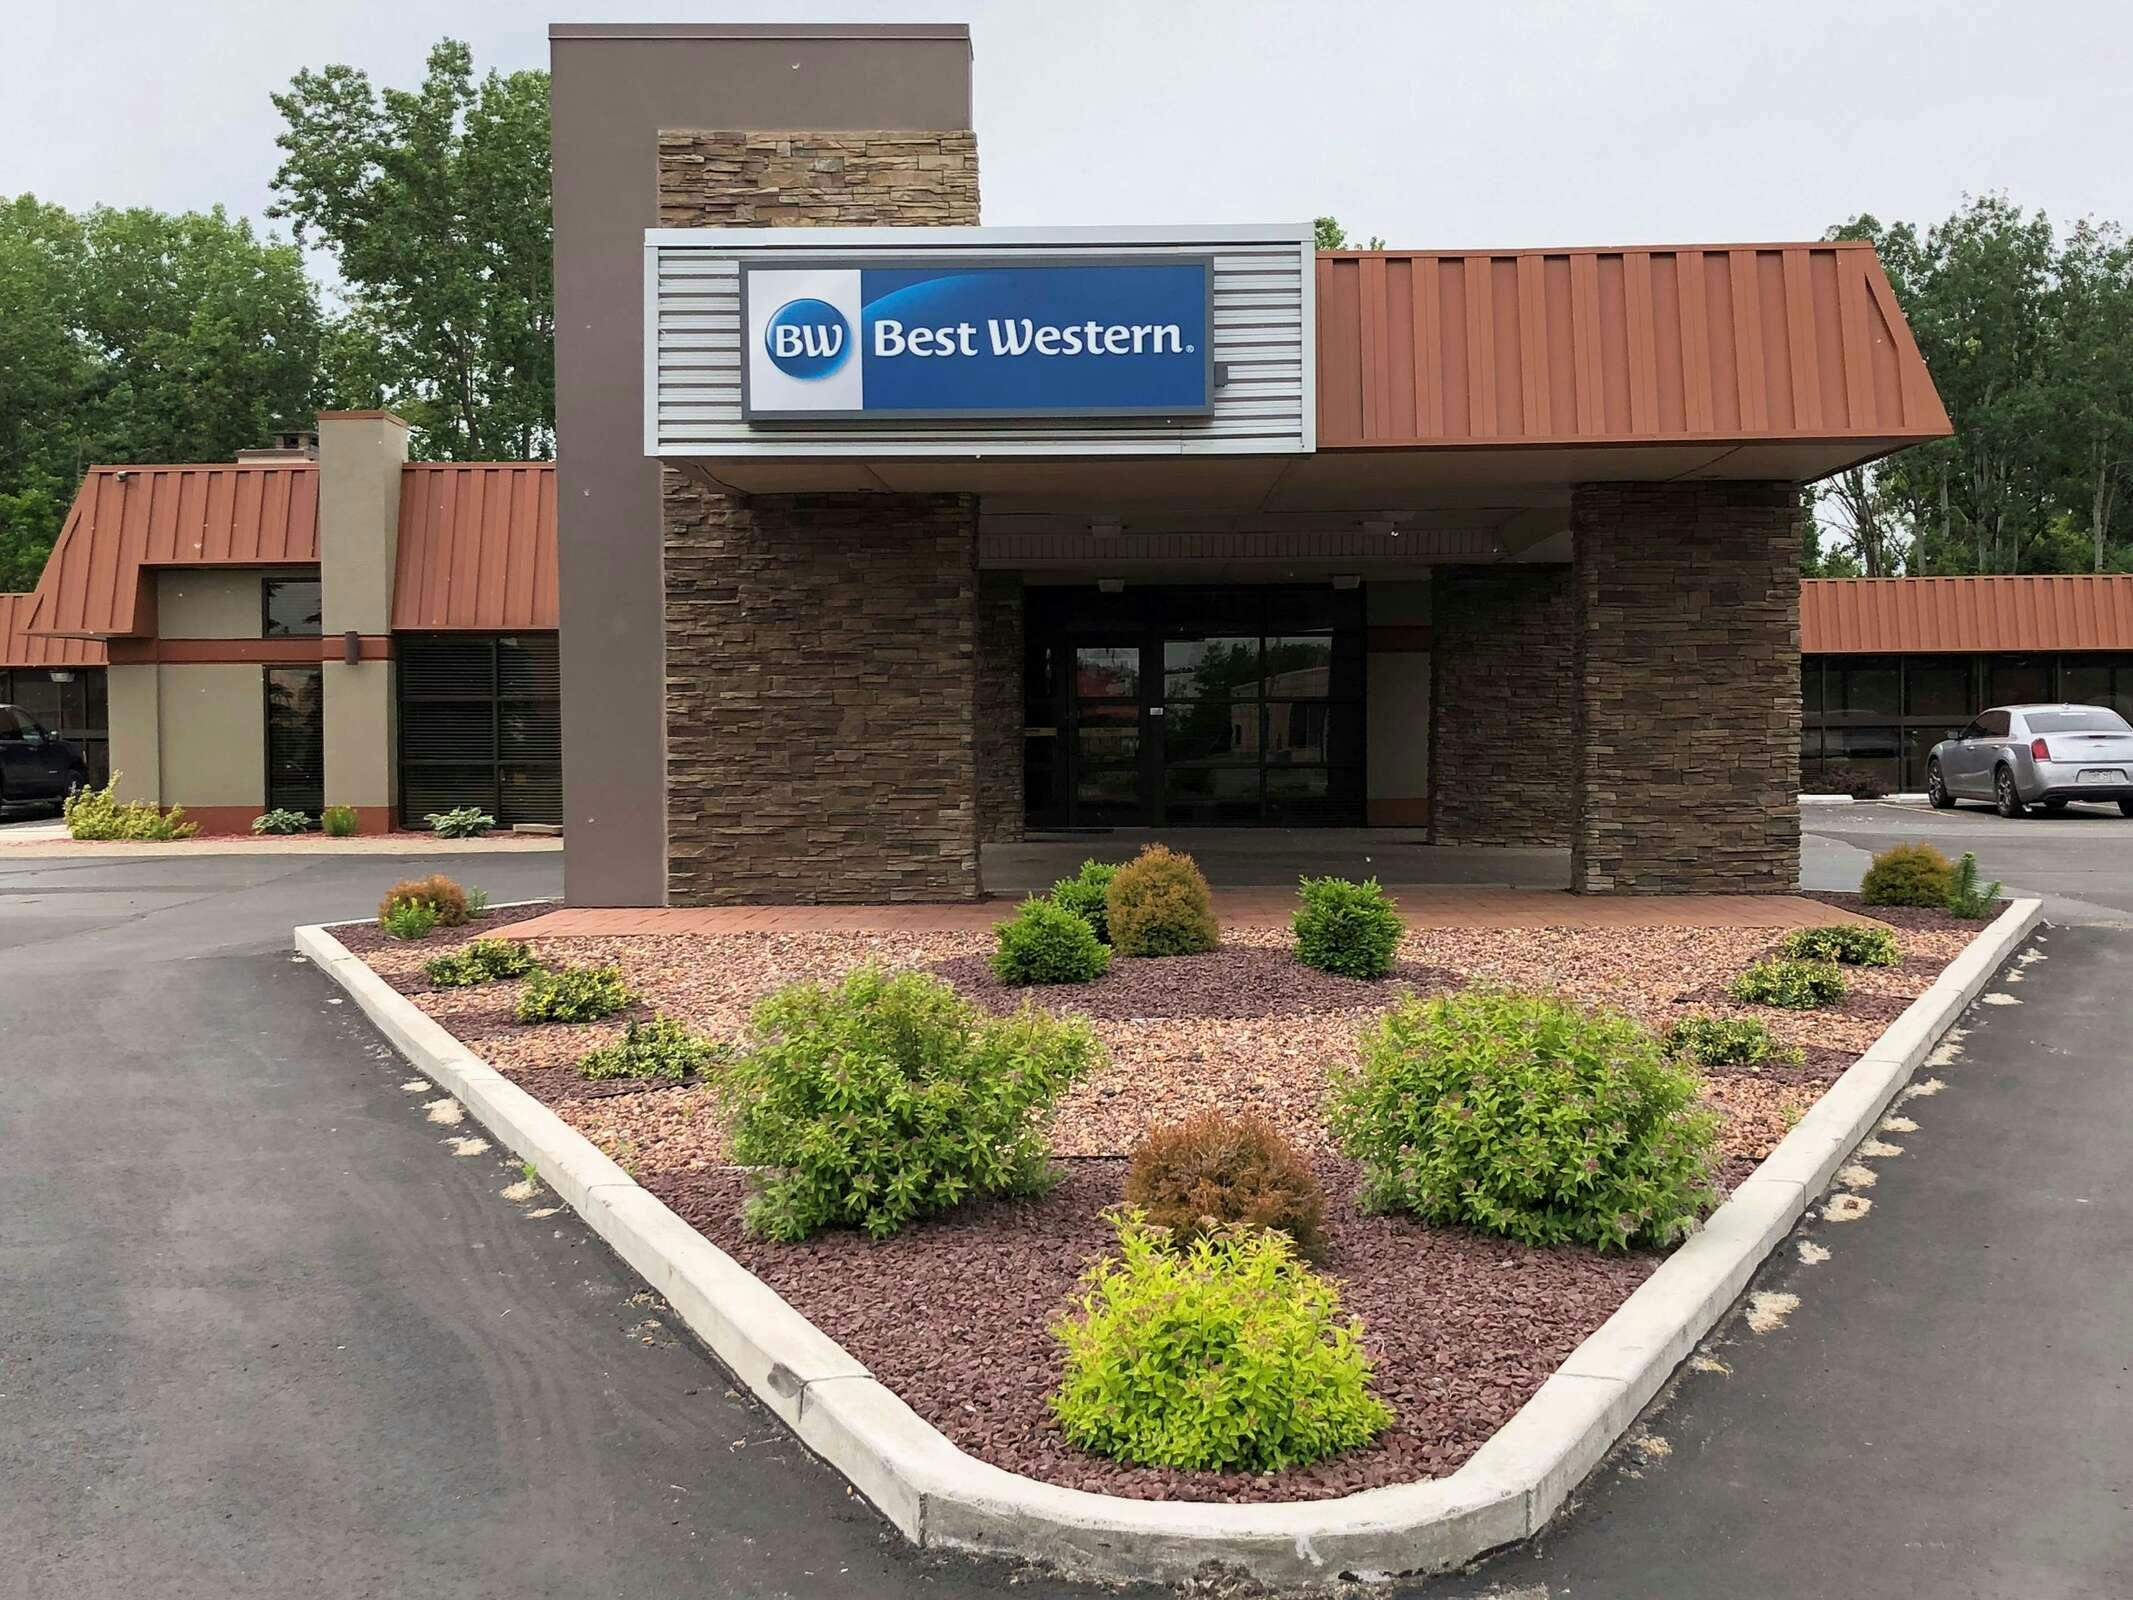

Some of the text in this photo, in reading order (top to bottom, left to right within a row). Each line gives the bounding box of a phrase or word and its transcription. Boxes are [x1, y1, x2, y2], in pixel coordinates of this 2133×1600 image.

[775, 324, 843, 358] BW
[874, 318, 1184, 357] Best Western
